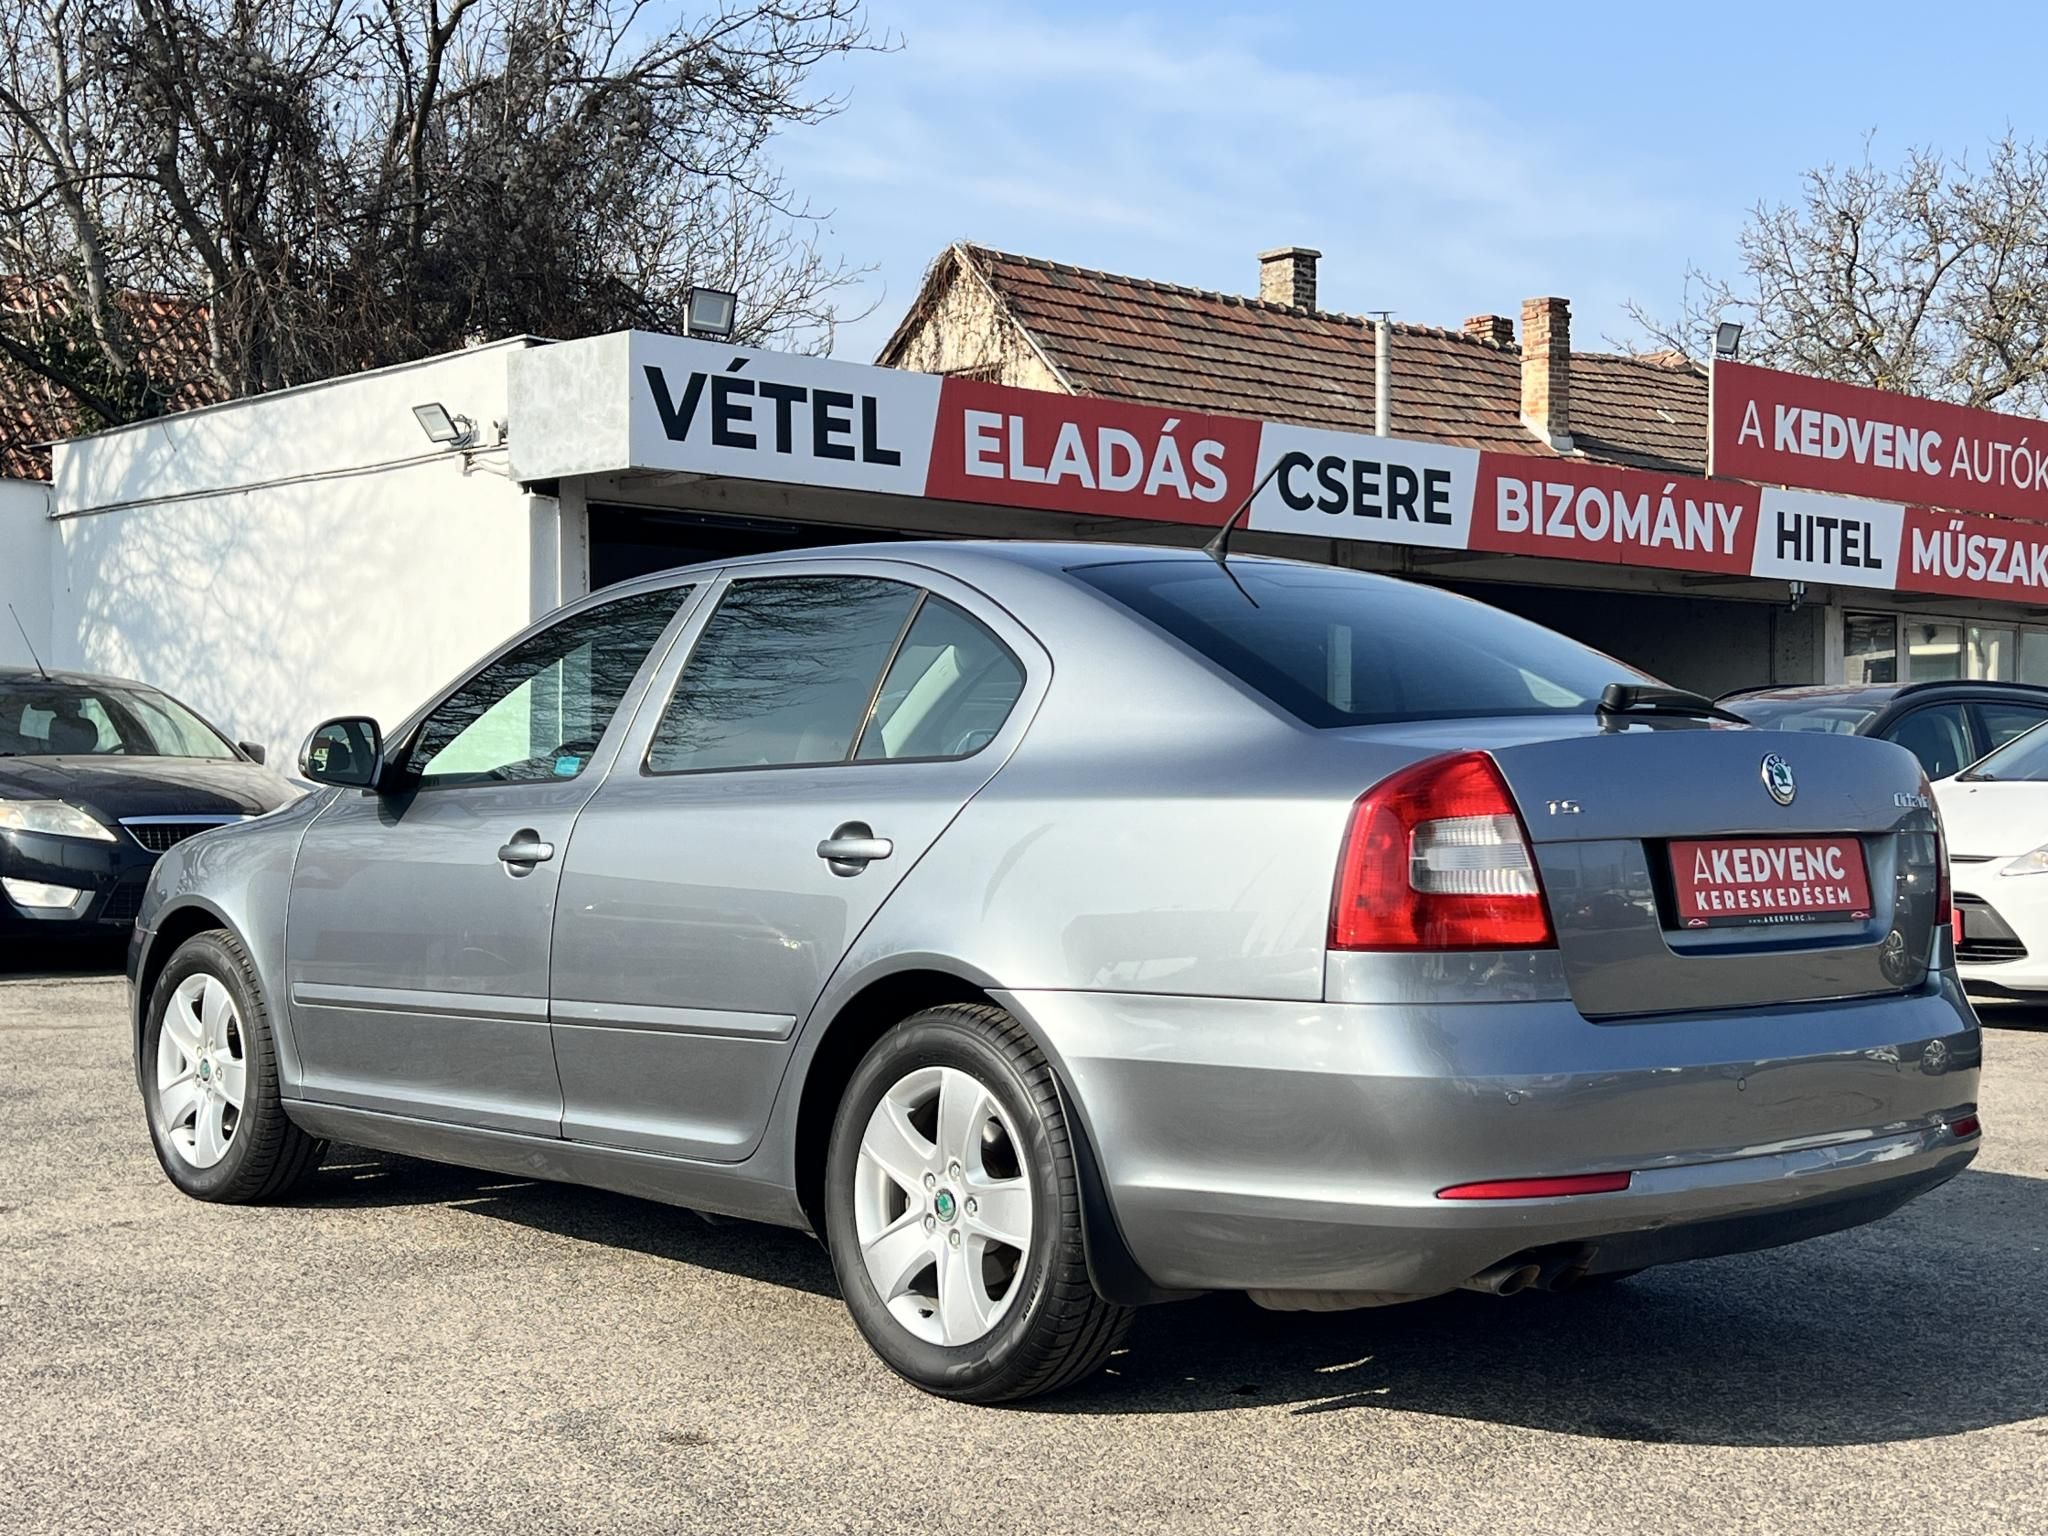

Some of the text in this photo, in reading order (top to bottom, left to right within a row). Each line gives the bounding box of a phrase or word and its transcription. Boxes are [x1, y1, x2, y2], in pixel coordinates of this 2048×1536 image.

[643, 357, 2048, 588] VÉTEL ELADÁS CSERE BIZOMÁNY HITEL MŰSZAK
[1737, 399, 2048, 491] A KEDVENC AUTÓK
[1695, 882, 1852, 911] KERESKEDÉSEM
